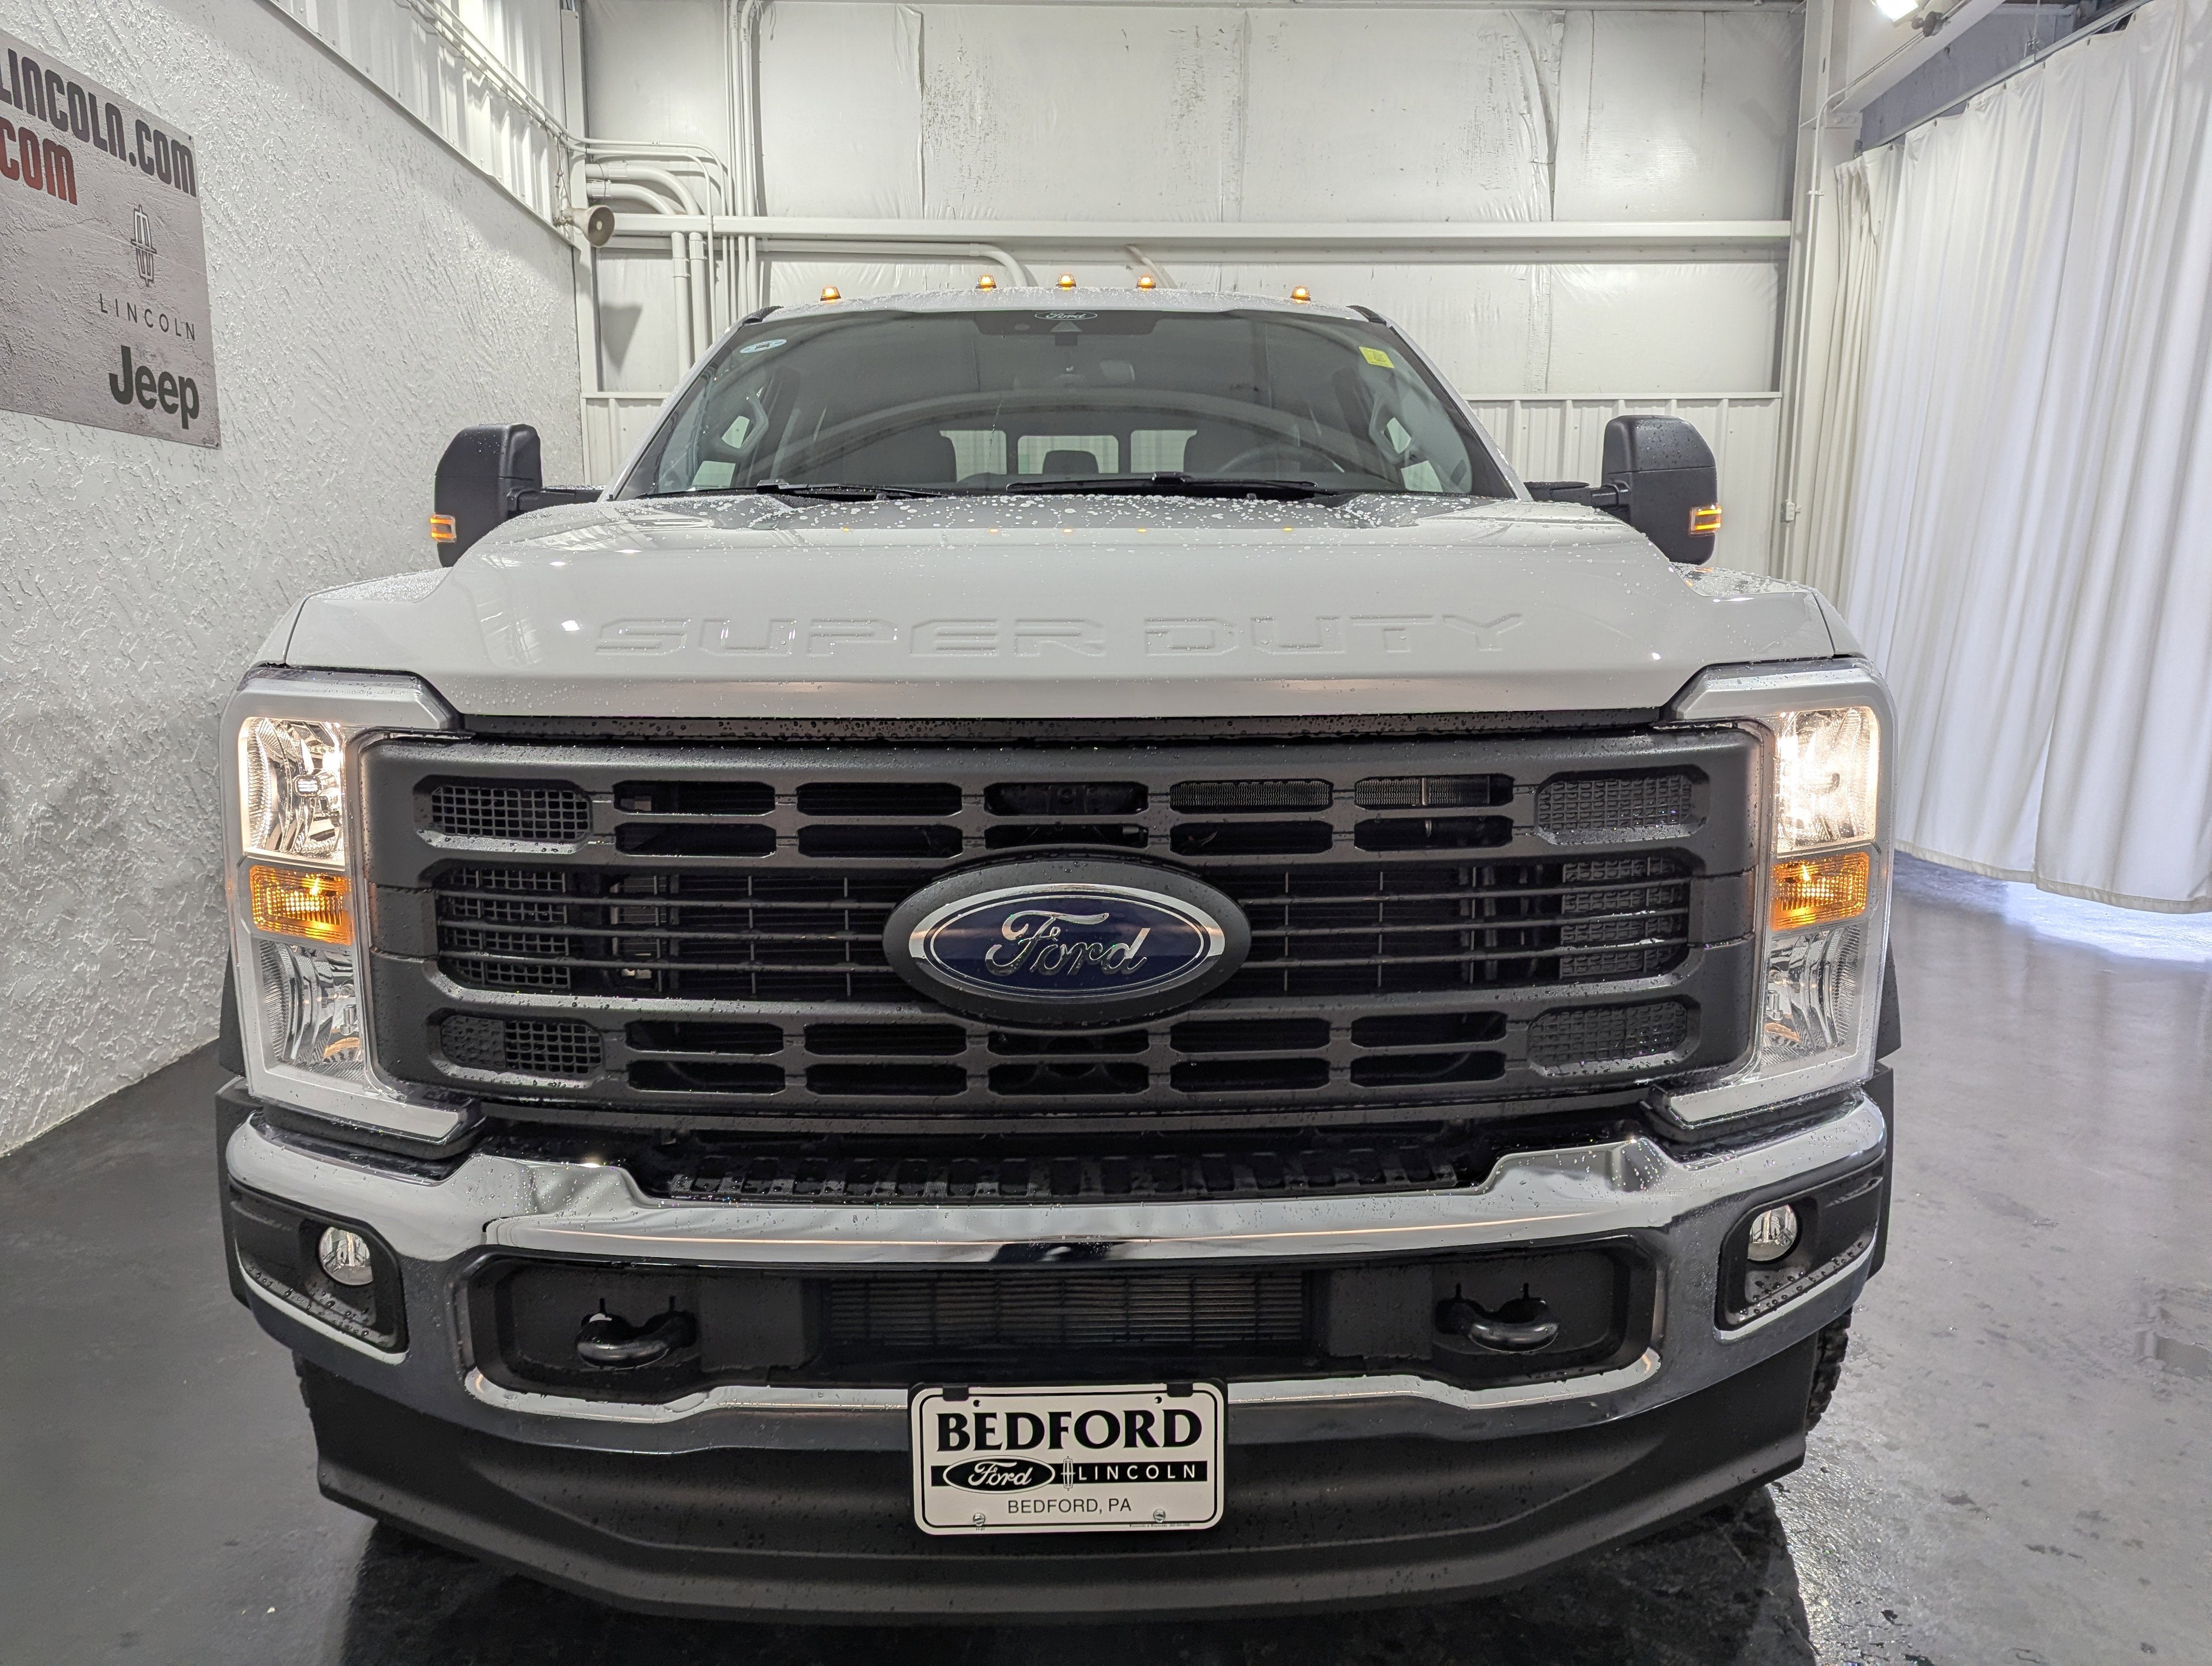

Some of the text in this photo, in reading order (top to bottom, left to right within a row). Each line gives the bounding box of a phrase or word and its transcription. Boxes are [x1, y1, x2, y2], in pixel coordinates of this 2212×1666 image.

[99, 293, 195, 341] LINCOLN
[108, 344, 200, 430] Jeep
[594, 613, 1522, 657] SUPER DUTY
[985, 910, 1147, 976] Ford
[935, 1409, 1202, 1452] BEDFORD
[968, 1461, 1195, 1486] Ford LINCOLN
[1008, 1498, 1132, 1515] BEDFORD, PA
